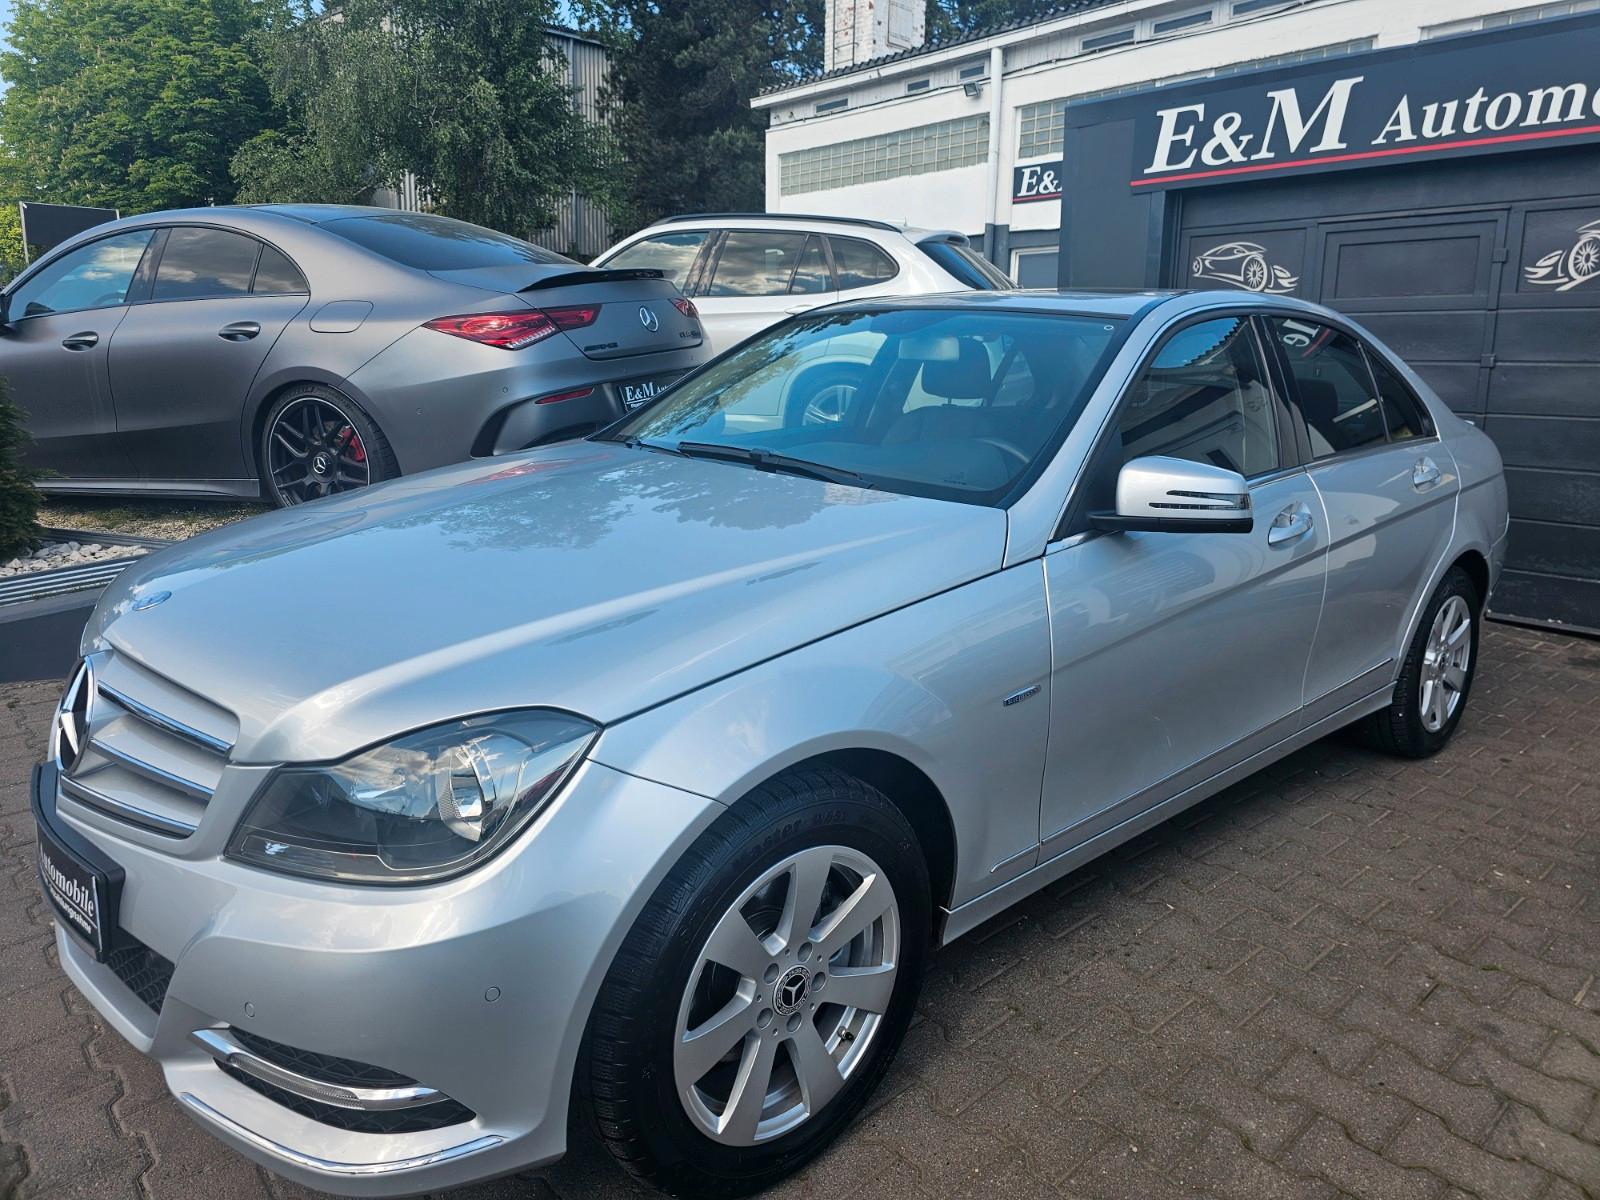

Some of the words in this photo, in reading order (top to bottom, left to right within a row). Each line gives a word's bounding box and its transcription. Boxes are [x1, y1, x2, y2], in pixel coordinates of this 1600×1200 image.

[1144, 75, 1364, 174] E&M
[1371, 82, 1600, 145] Autom
[1017, 166, 1062, 197] E&
[625, 382, 655, 401] E&M
